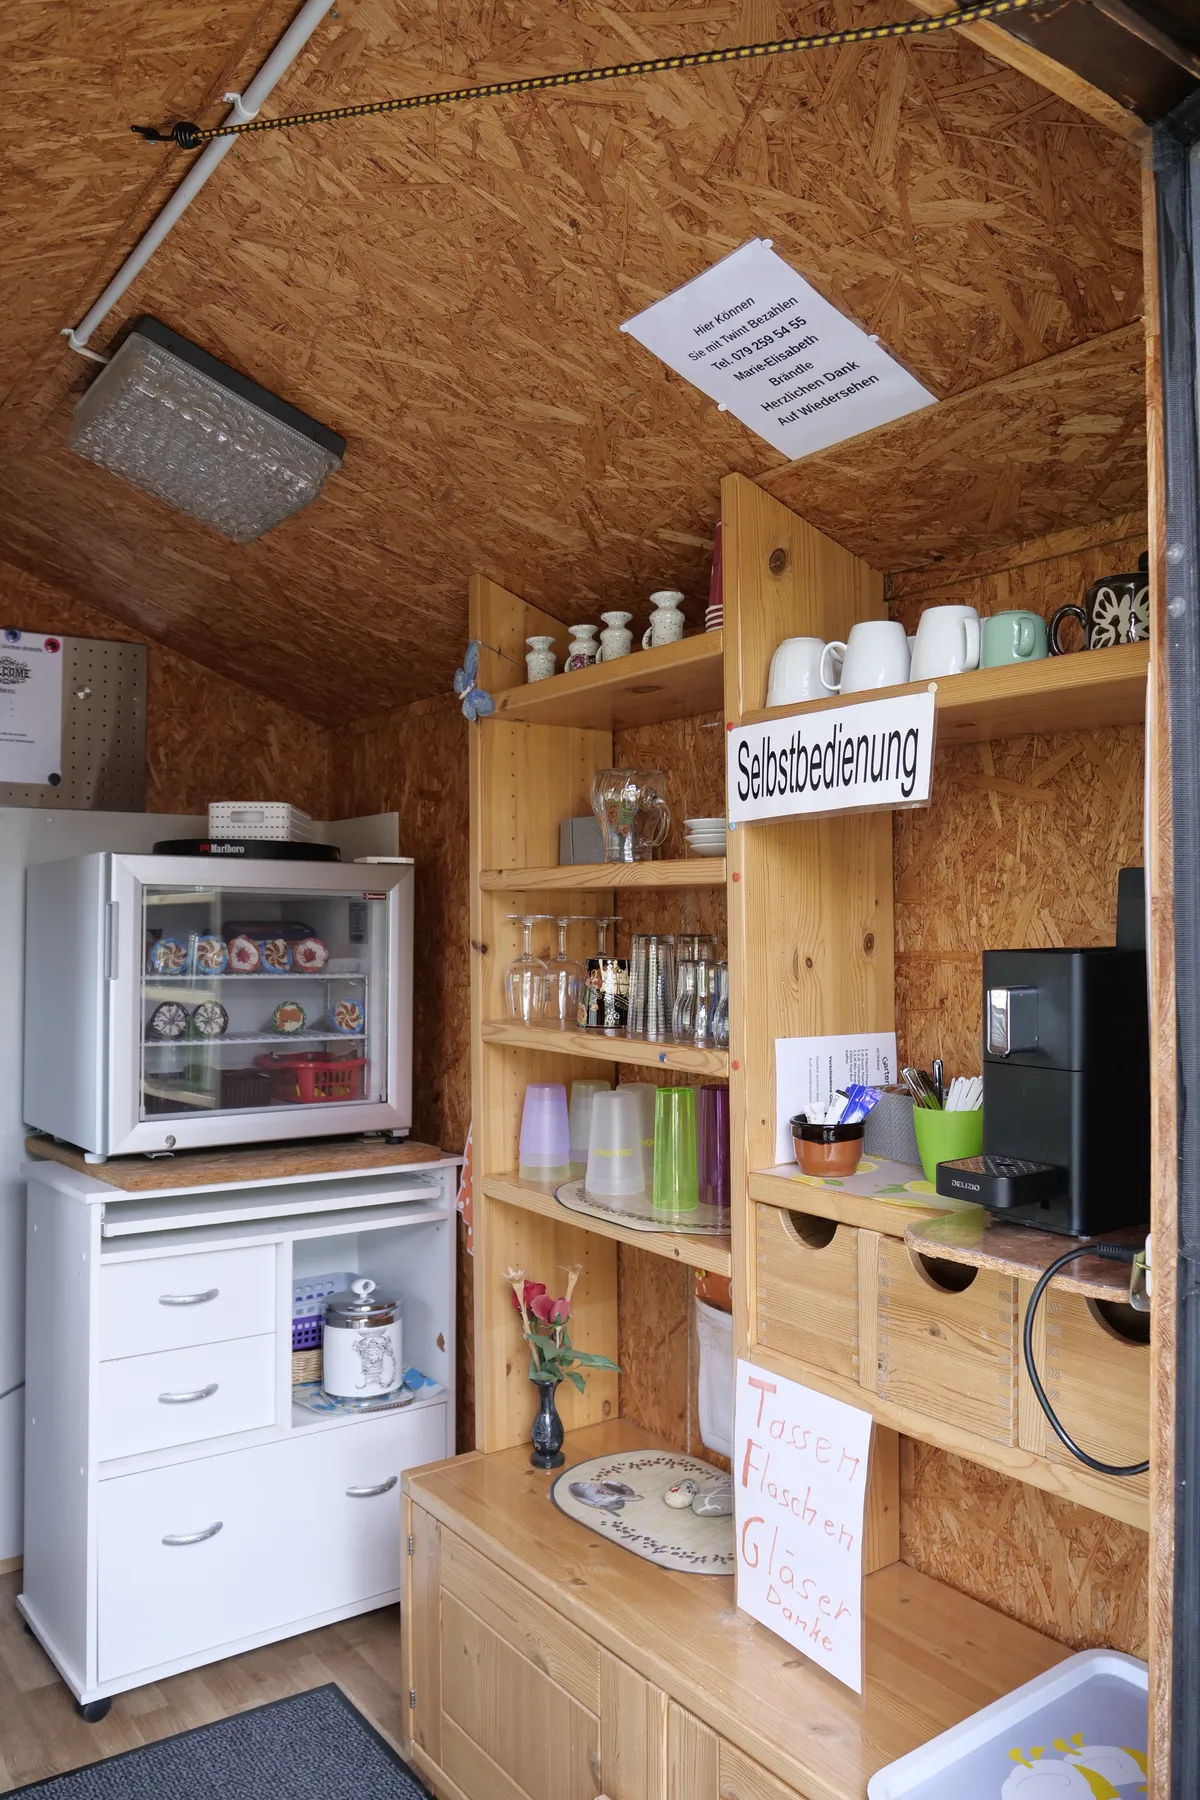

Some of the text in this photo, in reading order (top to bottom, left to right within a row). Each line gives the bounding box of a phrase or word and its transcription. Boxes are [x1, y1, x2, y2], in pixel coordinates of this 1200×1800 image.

[688, 297, 799, 362] Sie mit Twint Bezahlen
[693, 297, 756, 337] Hier Können
[710, 316, 807, 371] Tel. 079 259 54 55
[733, 334, 820, 381] Marie-Elisabeth
[760, 361, 861, 412] Herzlichen Dank
[768, 361, 815, 387] Brändle
[777, 375, 880, 426] Auf Wiedersehen
[737, 723, 919, 801] Selbstbedienung
[210, 844, 245, 854] Marlboro
[951, 1179, 980, 1191] DELIZIO
[748, 1376, 860, 1482] Tassen
[741, 1438, 854, 1551] Flaschen
[766, 1584, 833, 1652] Danke
